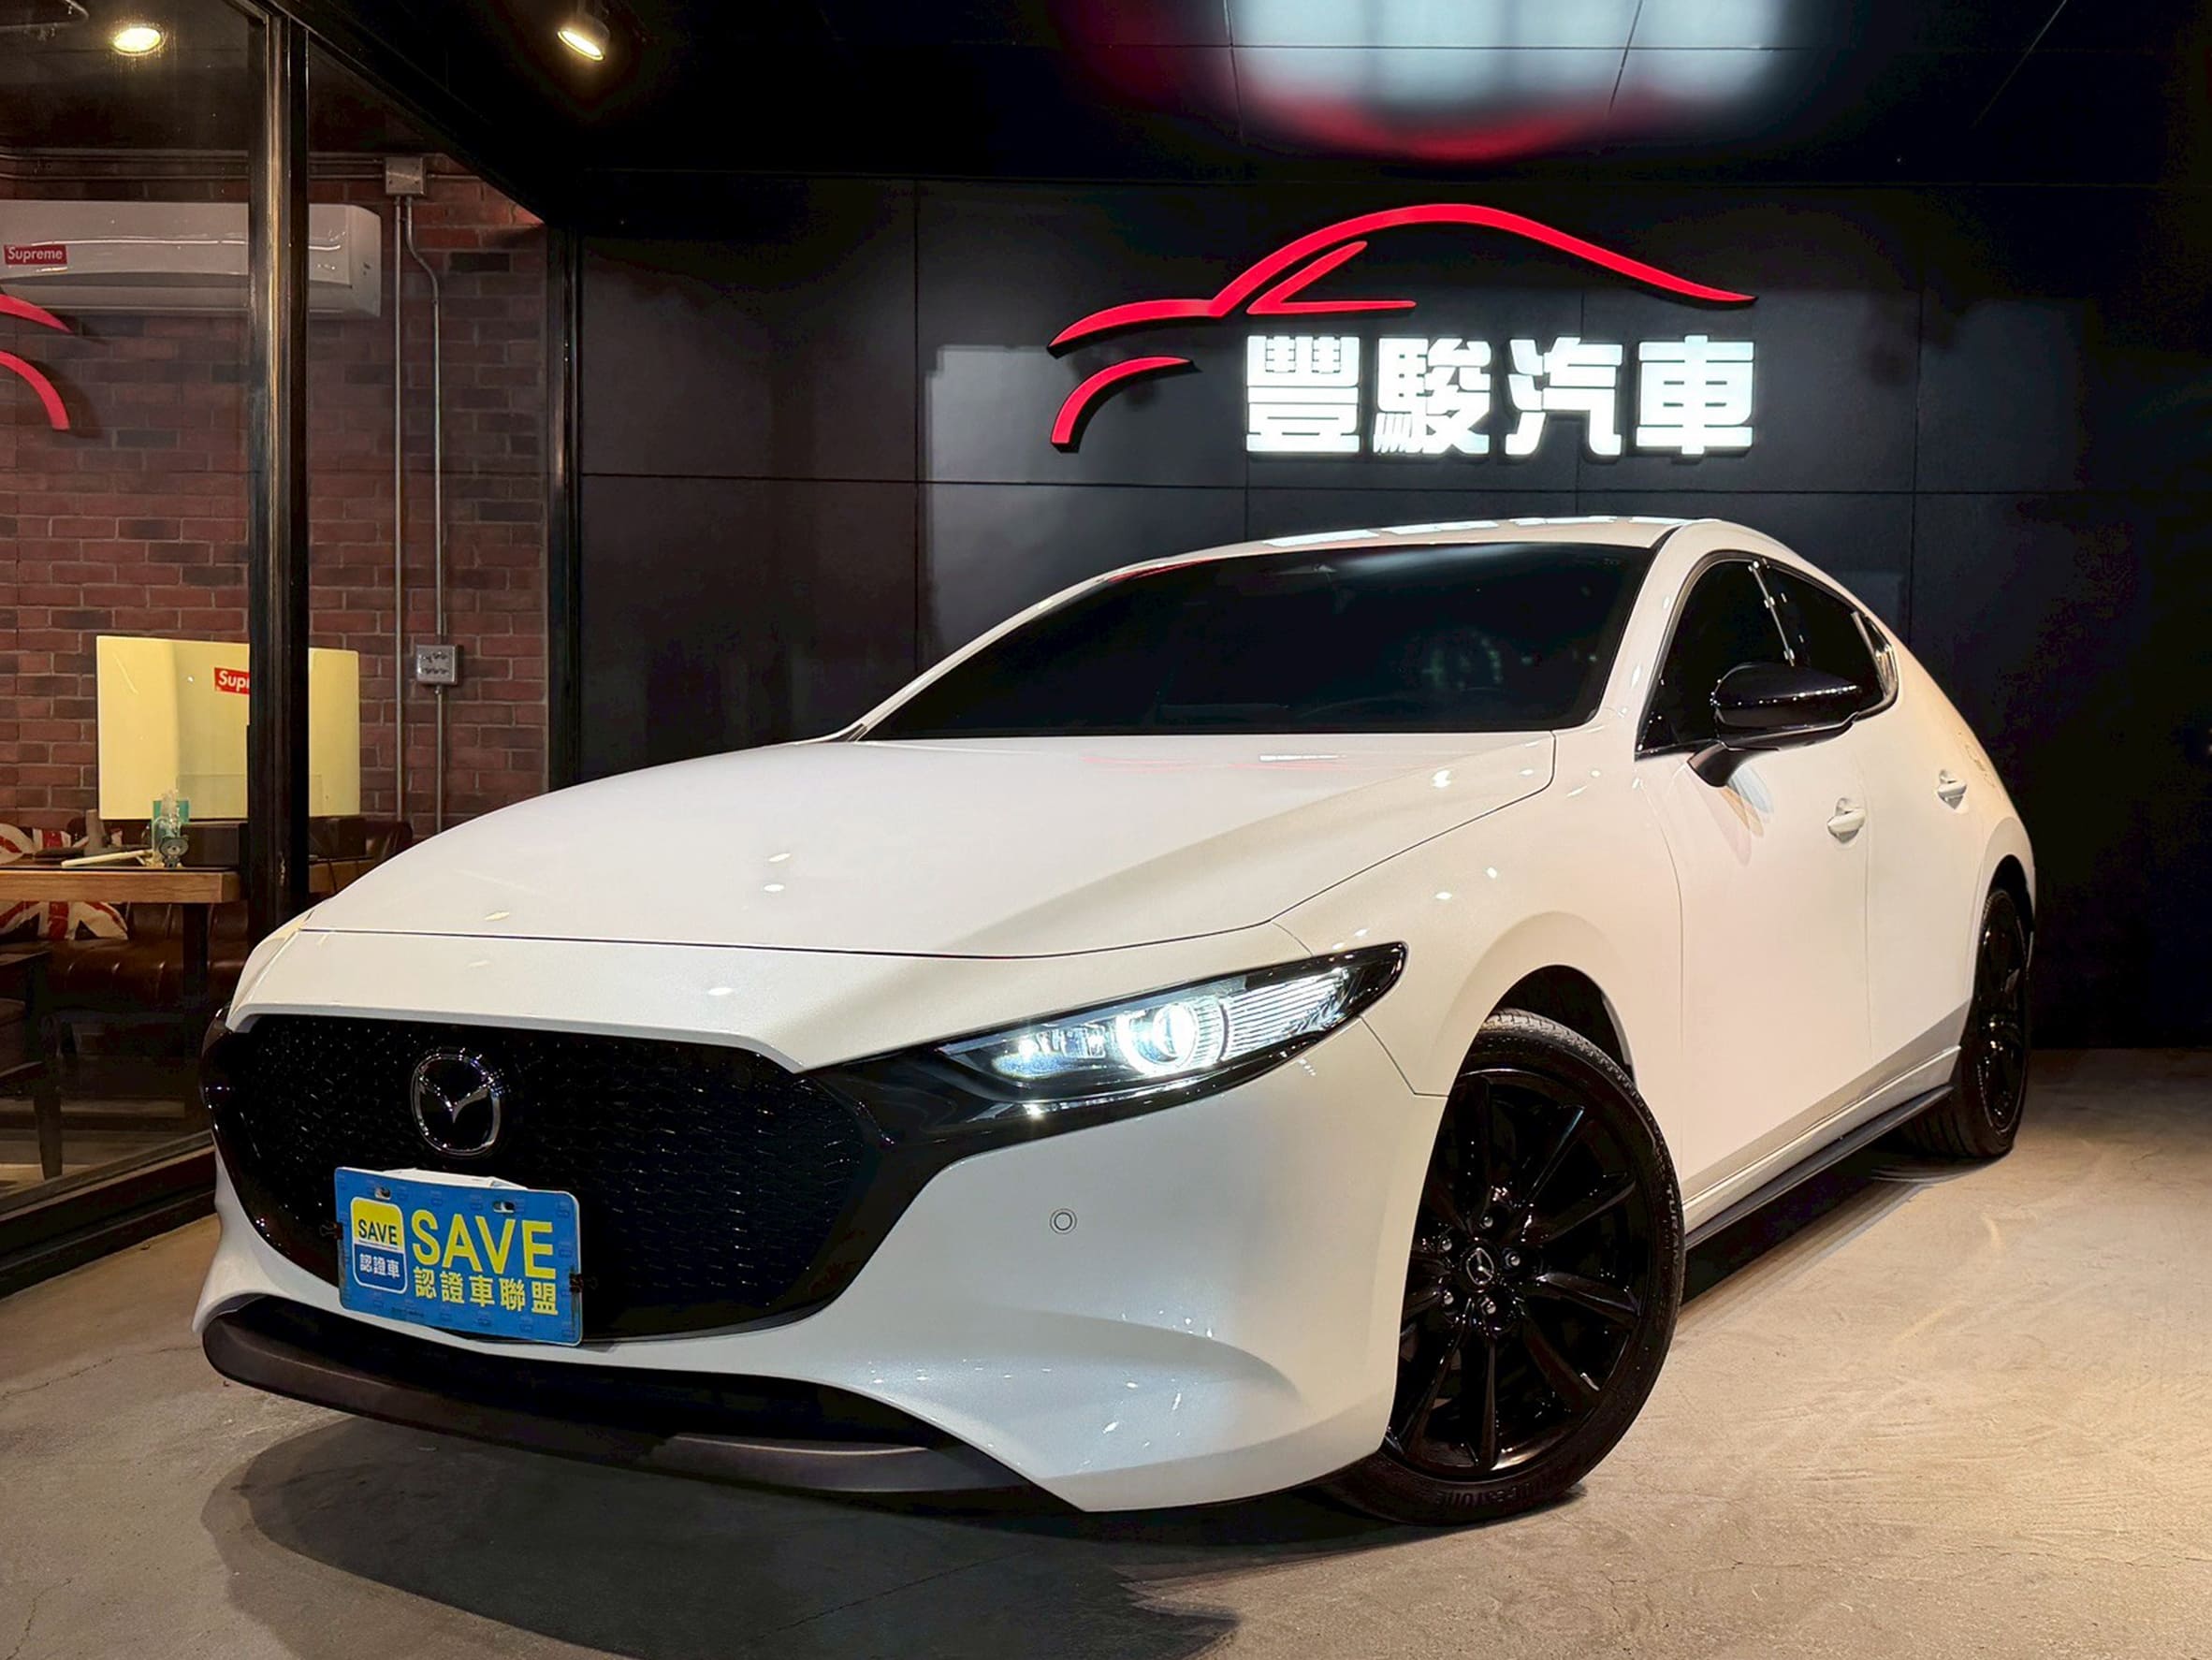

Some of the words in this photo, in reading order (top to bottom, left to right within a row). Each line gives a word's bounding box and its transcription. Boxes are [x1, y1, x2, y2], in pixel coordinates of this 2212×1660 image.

[7, 246, 63, 263] Supreme
[1246, 335, 1754, 456] 豐駿汽車
[358, 1219, 399, 1246] SAVE
[412, 1209, 557, 1280] SAVE
[359, 1253, 400, 1279] 認證車
[413, 1266, 559, 1316] 認證車聯盟
